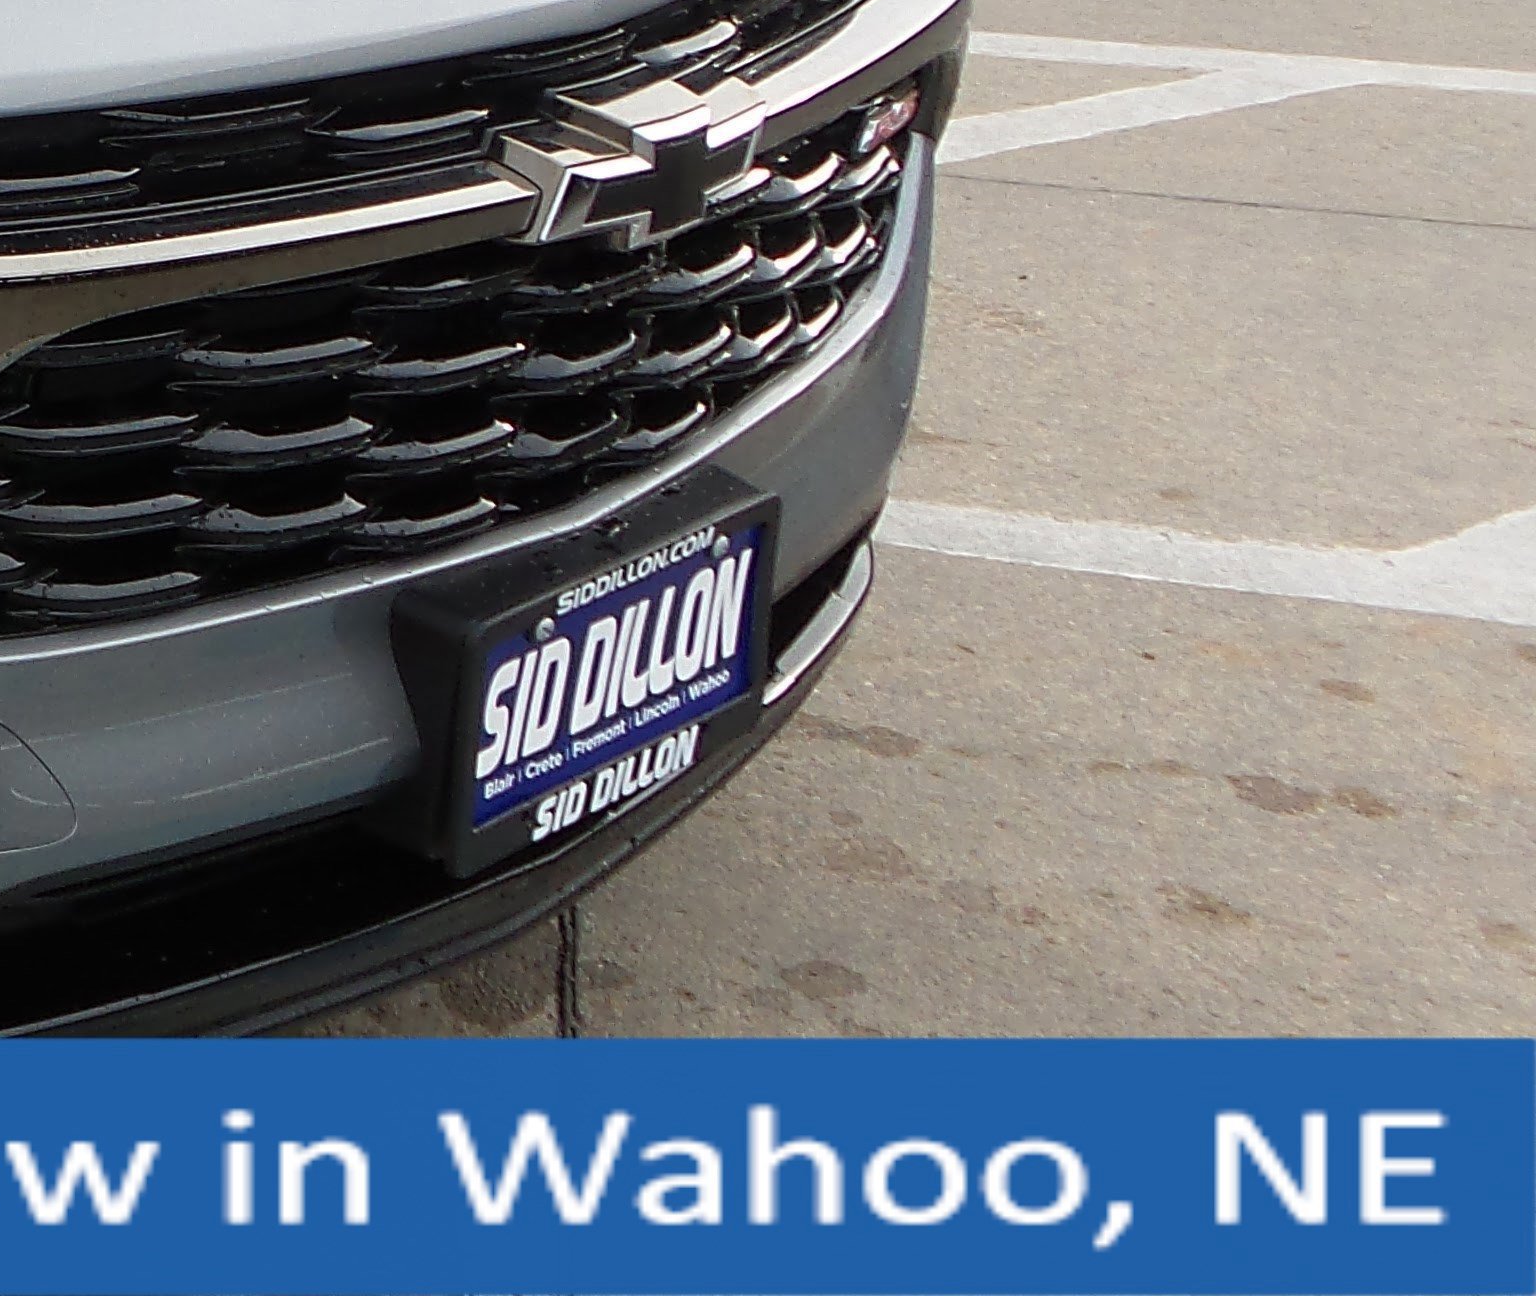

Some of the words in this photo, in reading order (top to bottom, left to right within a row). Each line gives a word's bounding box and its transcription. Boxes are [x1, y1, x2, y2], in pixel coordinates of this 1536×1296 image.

[555, 525, 716, 616] SIDDILLON.COM
[475, 635, 572, 780] SID
[569, 547, 753, 738] DILLON
[484, 774, 516, 800] Blair
[573, 718, 626, 759] Fremont
[634, 694, 681, 728] Lincoln
[688, 669, 731, 701] Wahoo
[531, 780, 588, 842] SID
[590, 723, 701, 814] DILLON
